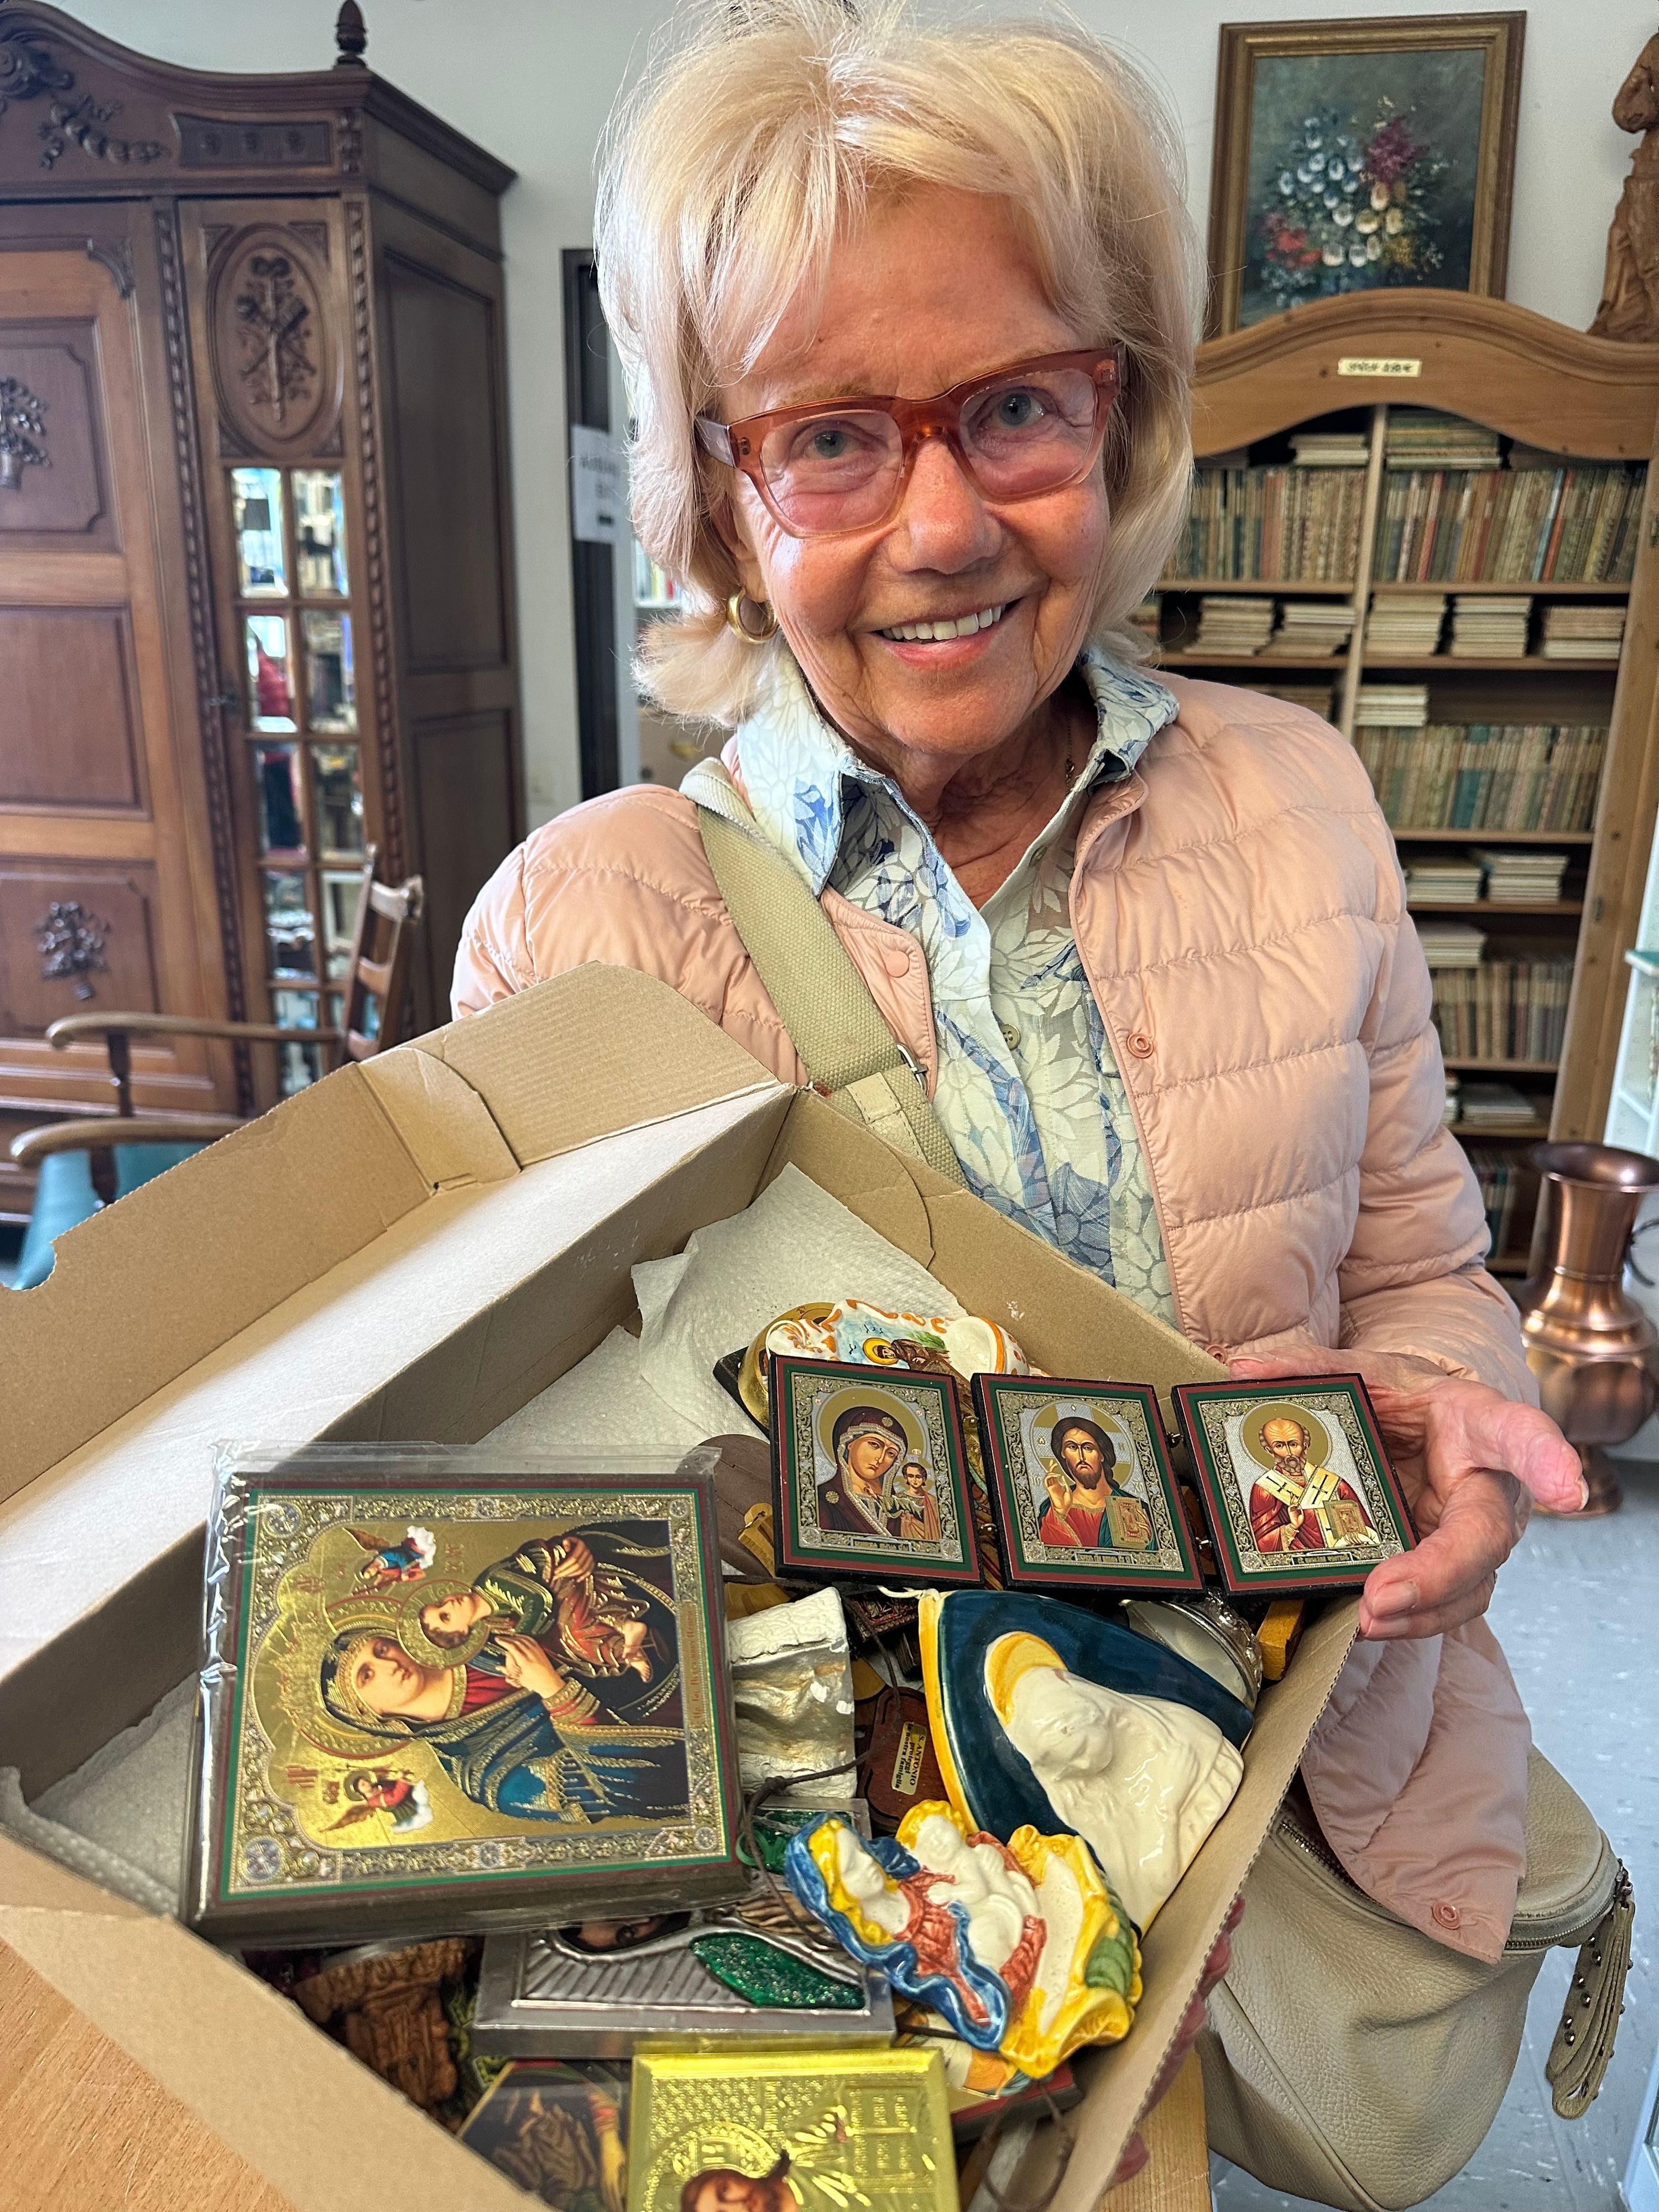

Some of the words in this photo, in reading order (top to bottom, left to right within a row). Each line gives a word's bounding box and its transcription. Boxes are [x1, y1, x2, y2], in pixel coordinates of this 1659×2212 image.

[902, 1732, 911, 1755] nostra
[904, 1741, 915, 1773] proteggi
[895, 1757, 906, 1788] famiglia
[910, 1743, 922, 1786] ANTONIO
